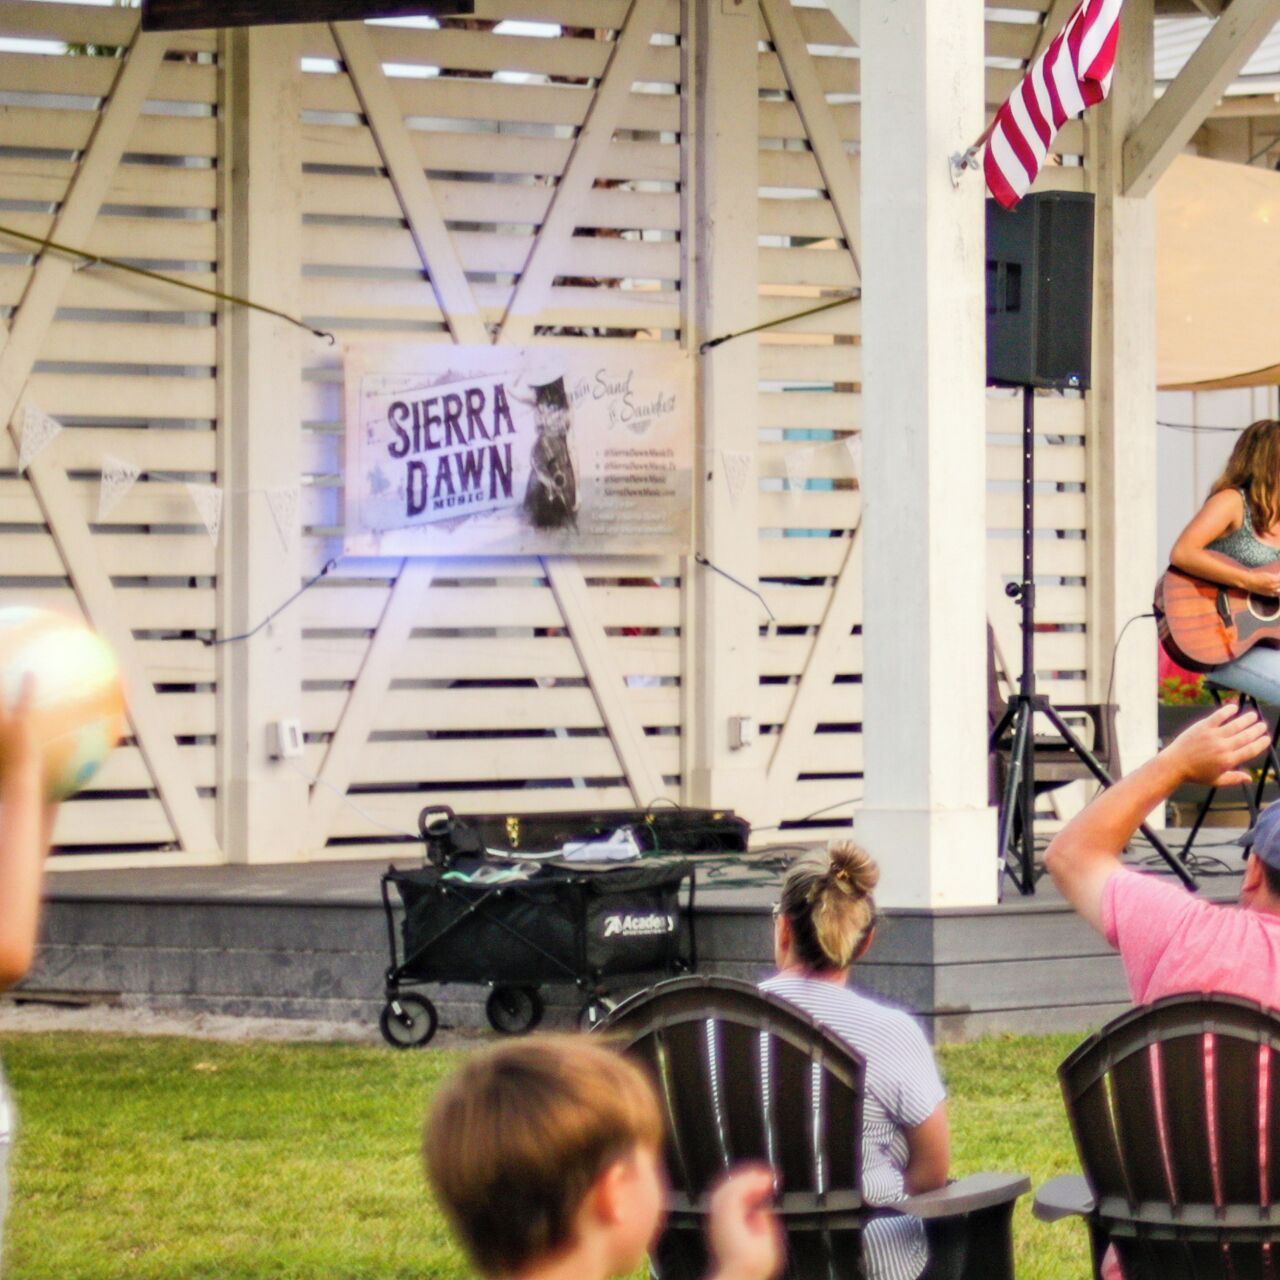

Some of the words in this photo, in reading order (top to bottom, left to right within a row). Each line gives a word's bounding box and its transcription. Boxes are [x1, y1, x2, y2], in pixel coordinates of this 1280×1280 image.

[387, 383, 516, 459] SIERRA
[406, 442, 513, 517] DAWN
[433, 491, 484, 510] MUSIC
